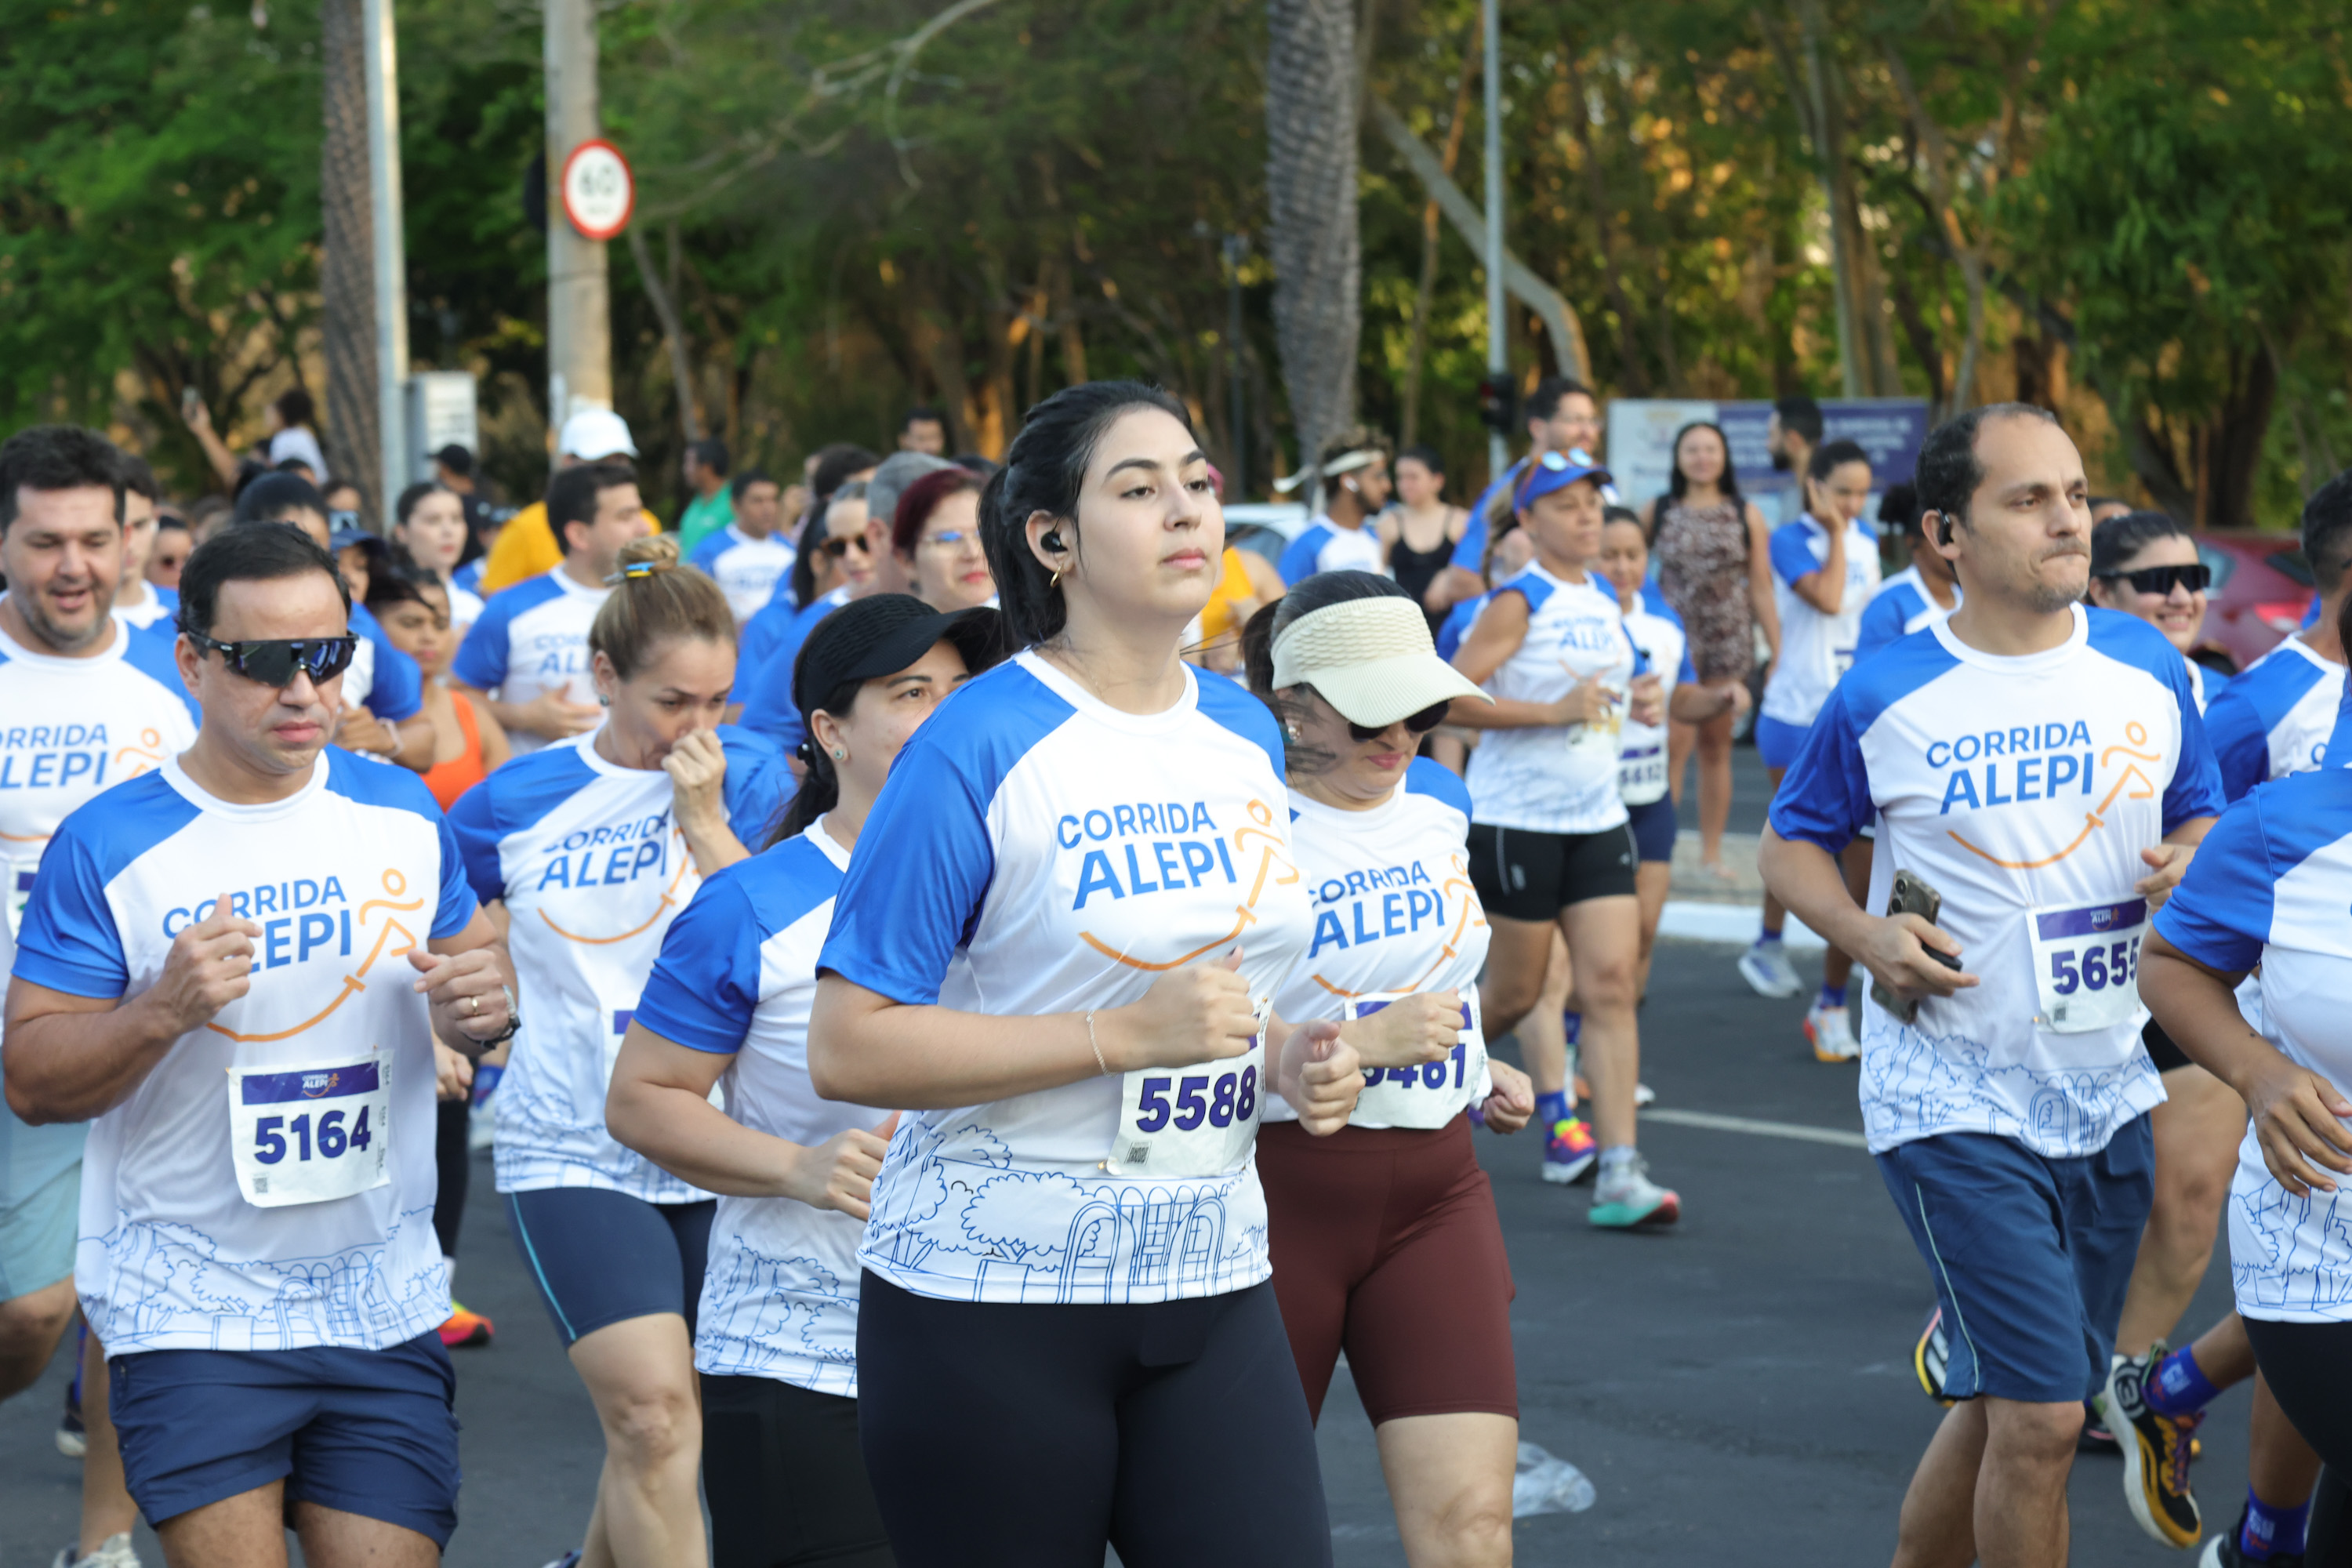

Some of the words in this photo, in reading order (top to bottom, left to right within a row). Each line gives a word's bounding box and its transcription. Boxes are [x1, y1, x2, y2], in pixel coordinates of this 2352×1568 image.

[0, 724, 108, 750] RRIDA
[1926, 720, 2092, 768] CORRIDA
[1940, 752, 2093, 816] ALEPI
[1058, 801, 1218, 849] CORRIDA
[536, 833, 666, 891] ALEPI
[1072, 837, 1237, 912] ALEPI
[249, 909, 351, 975] EPI
[1307, 888, 1446, 960] ALEPI
[2051, 935, 2140, 996] 5655
[1136, 1065, 1257, 1133] 5588
[253, 1104, 372, 1165] 5164
